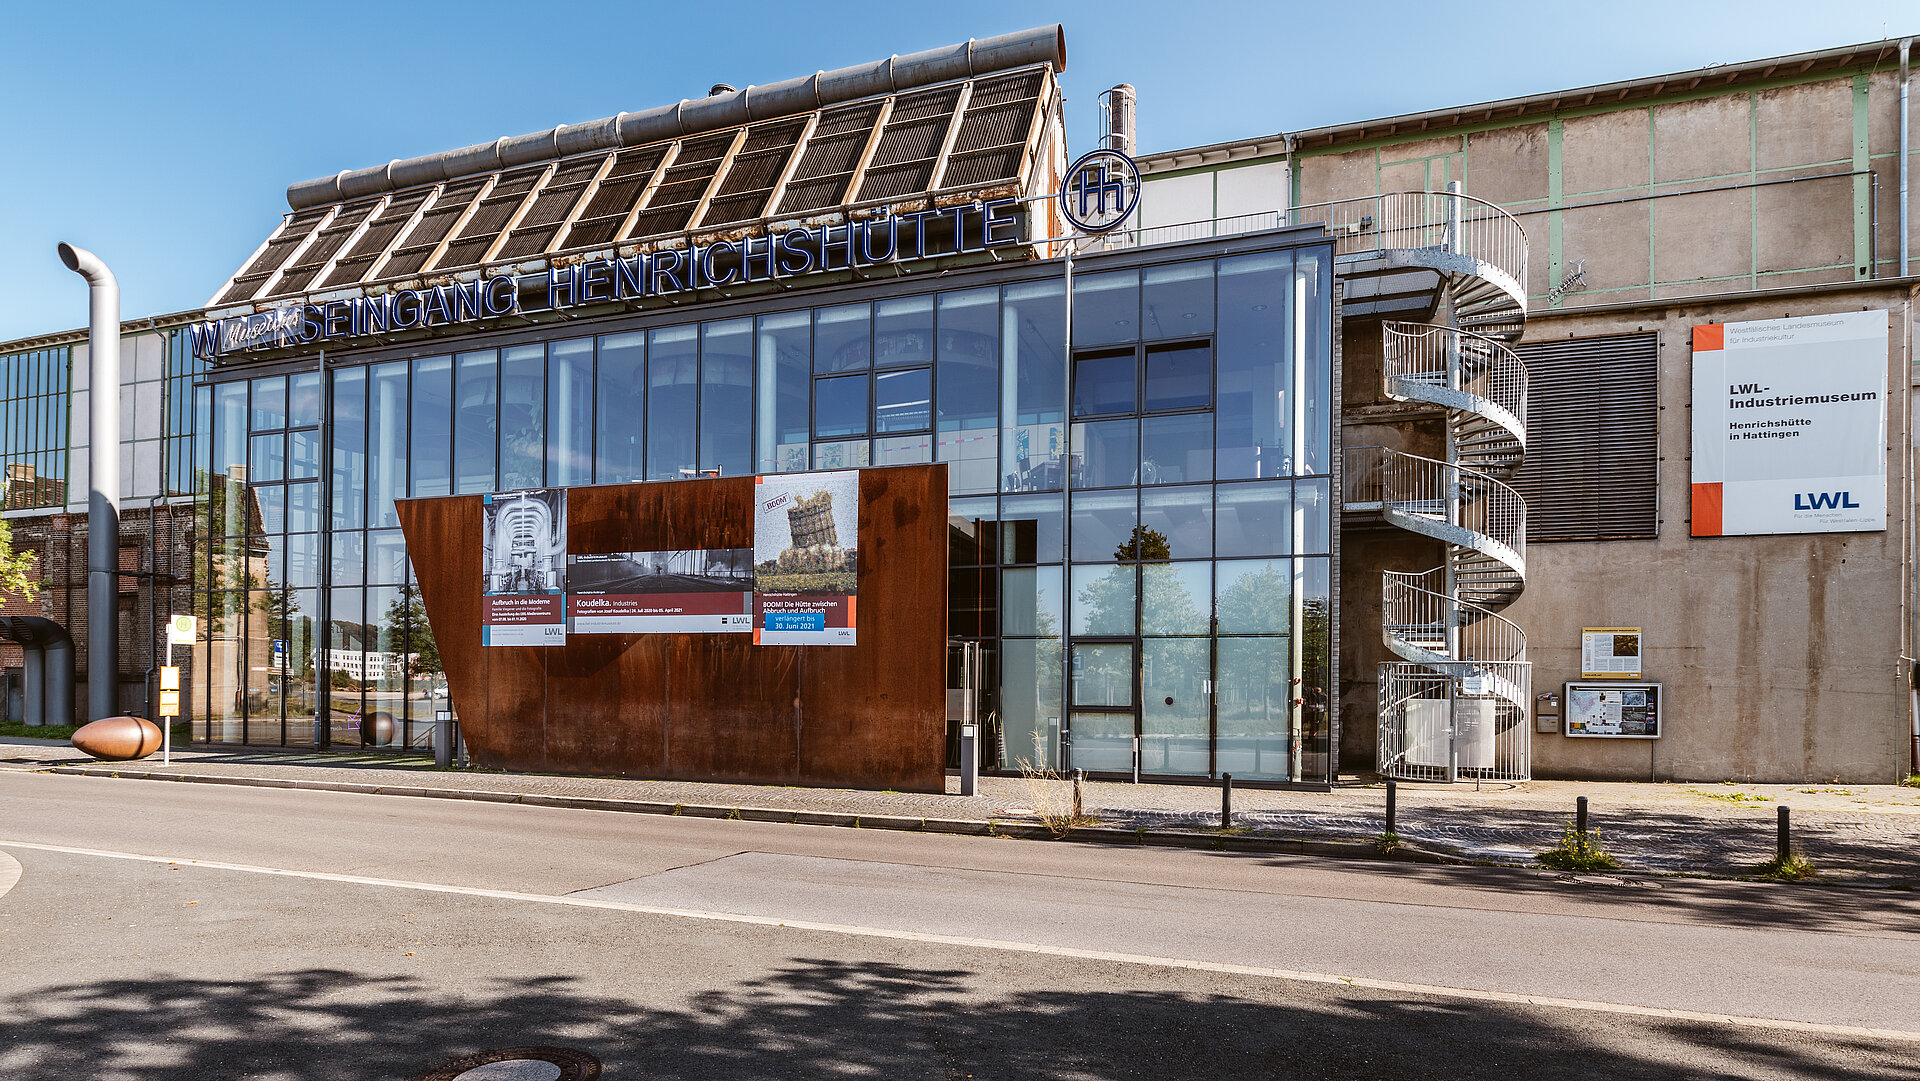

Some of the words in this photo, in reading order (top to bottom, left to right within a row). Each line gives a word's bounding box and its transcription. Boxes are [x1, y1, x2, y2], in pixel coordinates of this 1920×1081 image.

[547, 195, 1020, 308] HENRICHSHÜTTE
[1730, 324, 1781, 335] Westfälisches
[1783, 319, 1844, 331] Landesmuseum
[1742, 333, 1795, 343] Industriekultur
[1729, 383, 1770, 395] LWL-
[1729, 391, 1877, 409] Industriemuseum
[1729, 418, 1812, 430] Henrichshütte
[1729, 433, 1740, 441] in
[1743, 430, 1800, 440] Hattingen
[1794, 491, 1860, 511] LWL
[576, 598, 612, 607] Koudelka.
[545, 628, 563, 636] LWL
